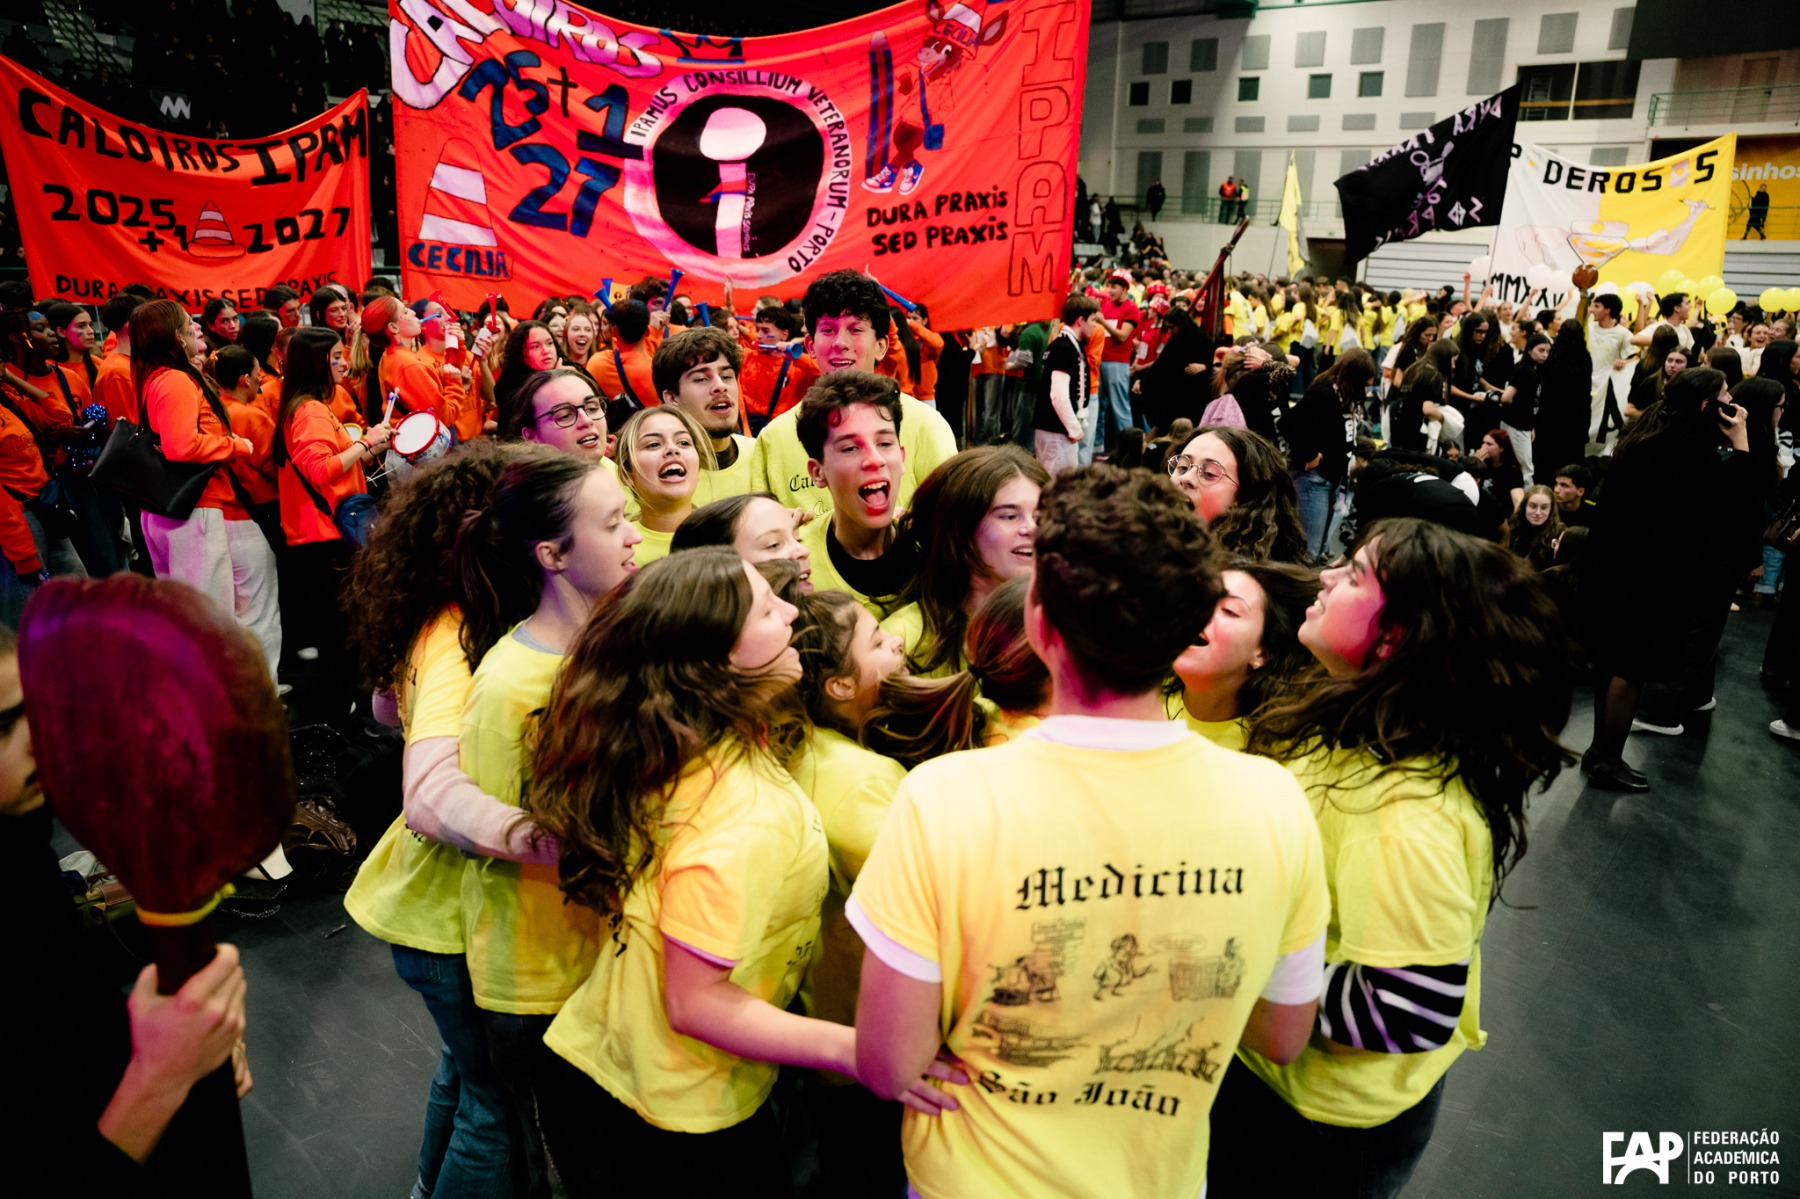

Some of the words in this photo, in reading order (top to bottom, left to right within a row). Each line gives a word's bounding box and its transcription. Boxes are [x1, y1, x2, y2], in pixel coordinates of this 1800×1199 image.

[683, 70, 802, 95] CONSILLIUM
[18, 88, 241, 173] CALOIROS
[250, 108, 367, 185] IPAM
[630, 86, 678, 137] IPAMUS
[806, 86, 850, 210] VETERANORUM
[1008, 1, 1076, 297] IPAM
[508, 142, 622, 238] 27
[867, 197, 928, 229] DURA
[42, 184, 177, 230] 2025
[242, 207, 350, 254] 2027
[871, 231, 918, 257] SED
[407, 243, 510, 278] CECILIA
[787, 222, 834, 274] PORTO
[56, 274, 118, 300] DURA
[155, 287, 214, 307] AXIS
[221, 287, 268, 309] SED
[1015, 861, 1245, 911] Medicina
[976, 1069, 1058, 1107] São
[1073, 1081, 1181, 1118] João
